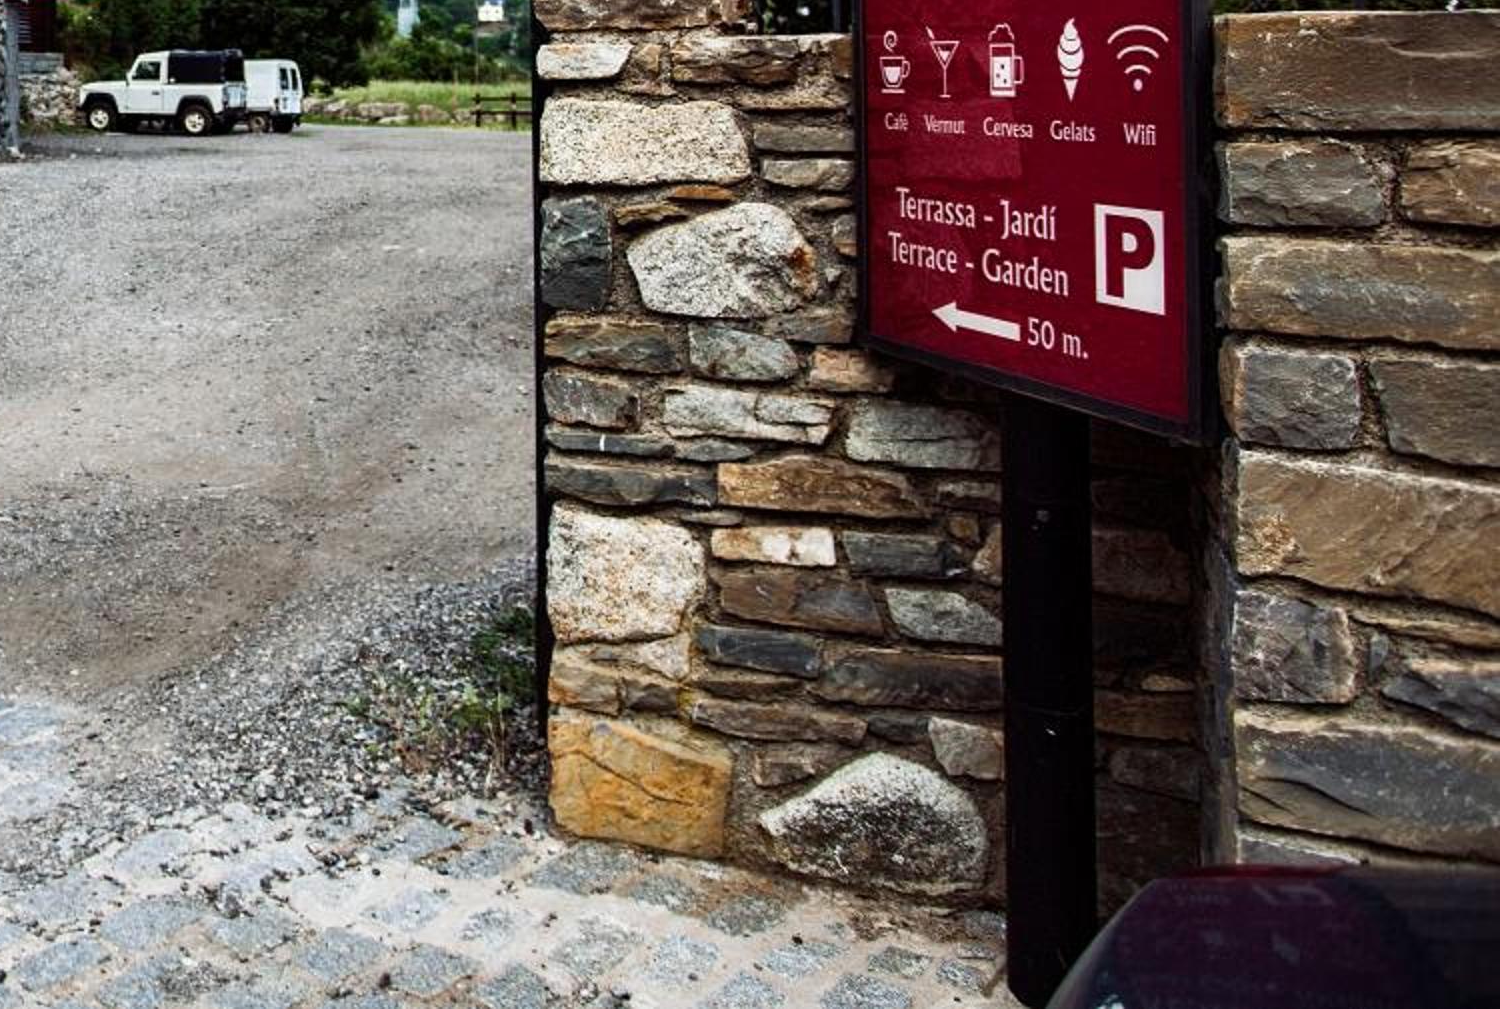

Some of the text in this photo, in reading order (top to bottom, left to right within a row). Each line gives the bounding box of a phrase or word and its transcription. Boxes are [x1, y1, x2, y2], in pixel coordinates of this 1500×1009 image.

[983, 117, 1033, 138] Cervesa
[1050, 120, 1095, 142] Gelats
[1124, 123, 1156, 145] Wifi
[896, 187, 975, 228] Terrassa
[1000, 200, 1056, 240] Jardí
[888, 231, 957, 273] Terrace
[982, 249, 1068, 296] Garden
[1105, 213, 1156, 299] P
[1028, 317, 1088, 358] 50 m.
